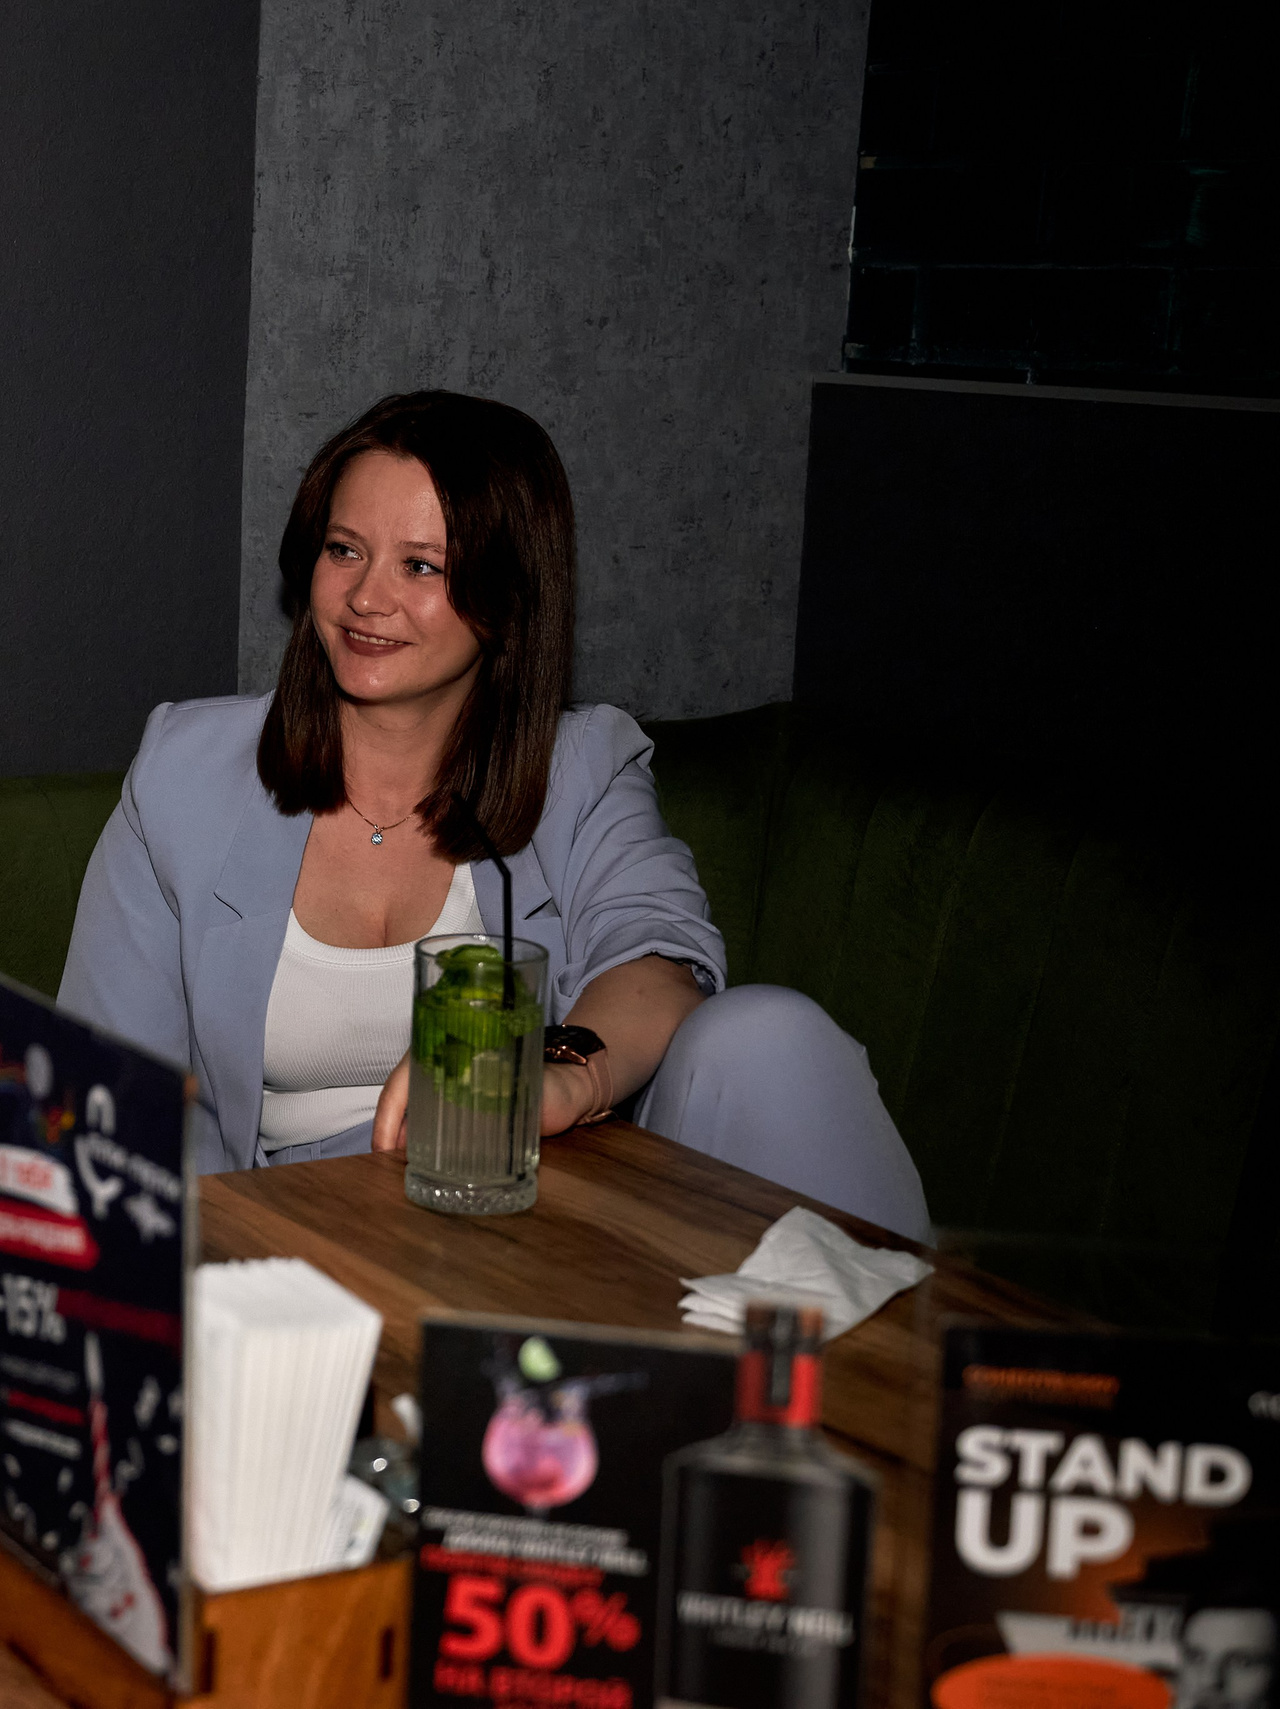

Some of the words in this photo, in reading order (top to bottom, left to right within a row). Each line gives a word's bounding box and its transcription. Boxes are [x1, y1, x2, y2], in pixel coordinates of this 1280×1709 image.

[955, 1424, 1252, 1507] STAND
[955, 1488, 1135, 1580] UP
[440, 1575, 640, 1669] 50%
